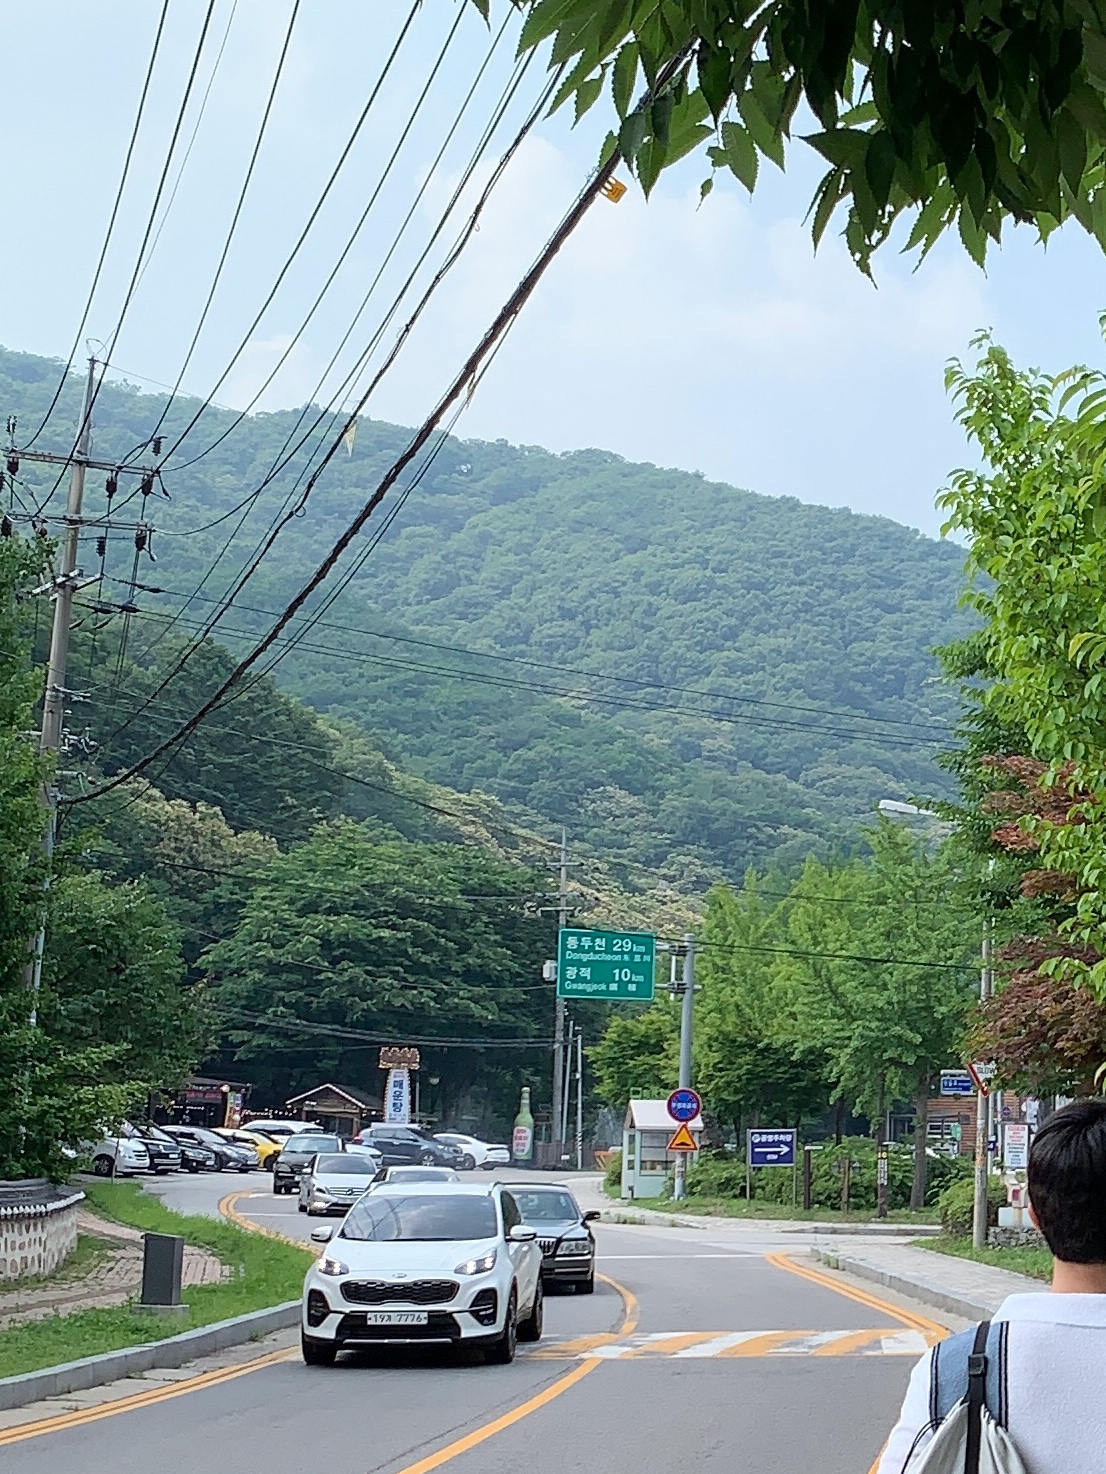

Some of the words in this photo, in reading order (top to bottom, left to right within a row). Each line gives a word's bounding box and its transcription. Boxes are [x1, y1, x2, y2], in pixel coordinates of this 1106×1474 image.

[567, 937, 606, 950] 동두천
[566, 951, 621, 961] Dongducheon
[566, 967, 590, 980] 광적
[565, 981, 606, 992] Gwangjeok
[977, 1066, 995, 1075] SLOW
[392, 1080, 404, 1113] 매운탕
[396, 1313, 423, 1323] 7776
